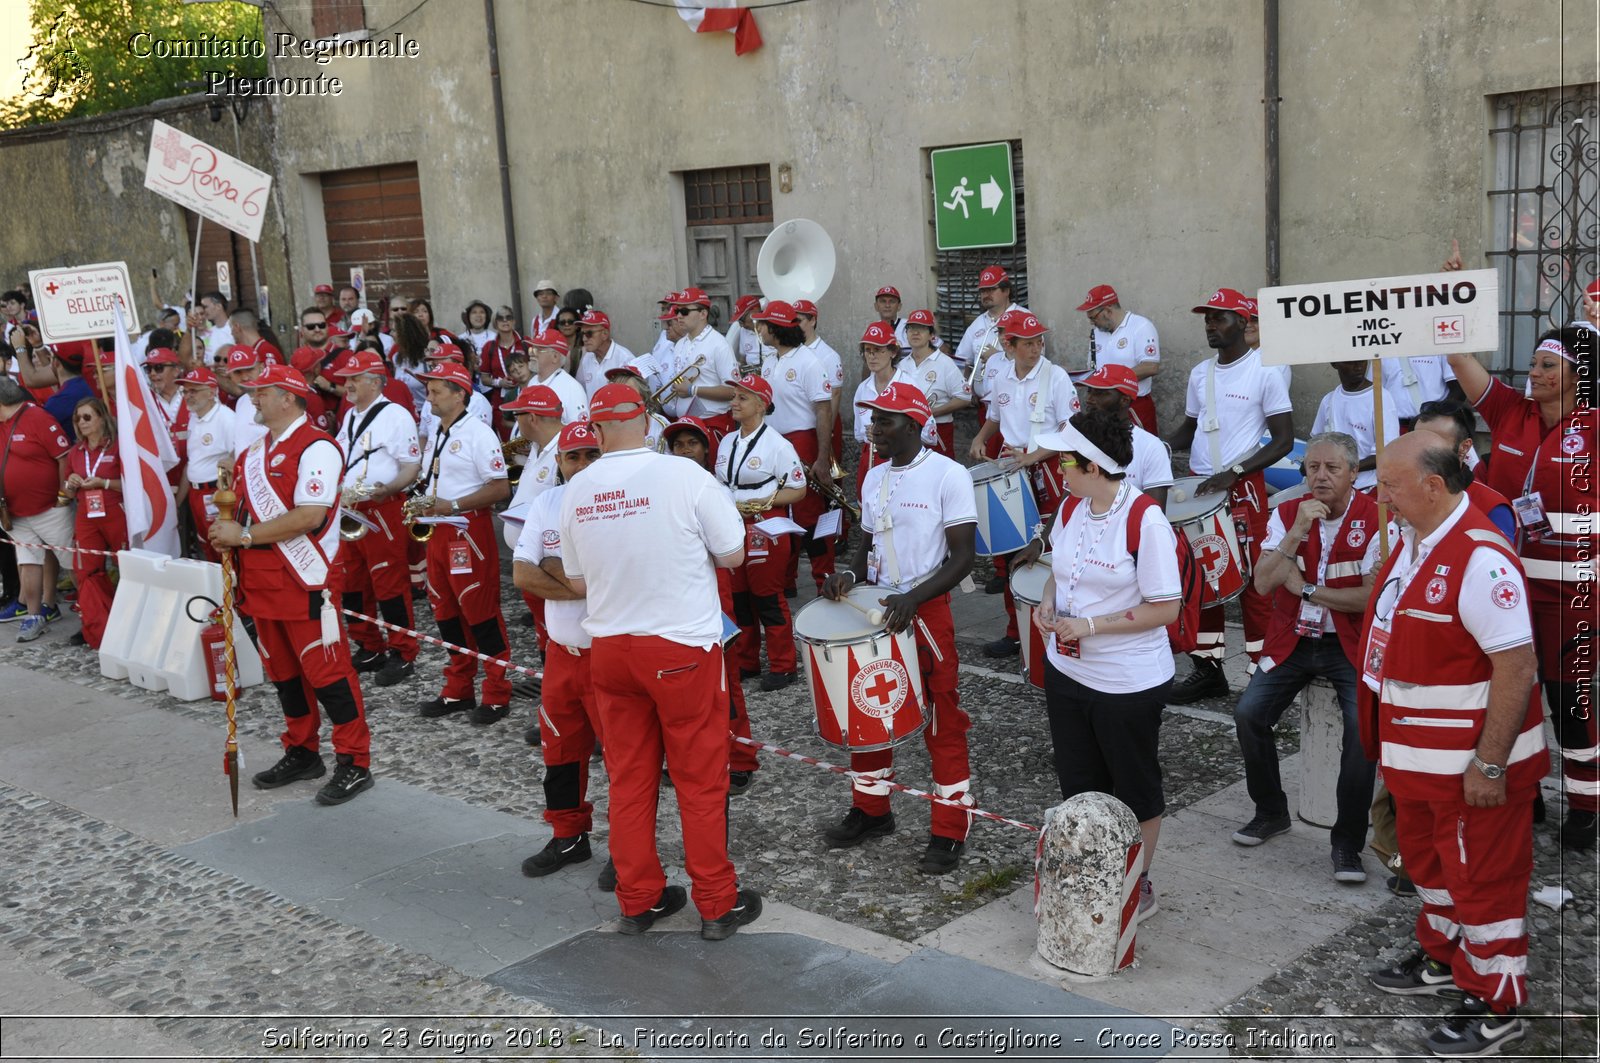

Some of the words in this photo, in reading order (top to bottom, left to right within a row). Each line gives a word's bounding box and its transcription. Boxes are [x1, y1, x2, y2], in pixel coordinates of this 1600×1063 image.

[159, 143, 238, 203] Roma
[243, 187, 266, 217] 6
[1277, 281, 1477, 319] TOLENTINO
[1357, 317, 1396, 331] -MC-
[1352, 332, 1403, 347] ITALY
[594, 489, 626, 504] FANFARA
[576, 506, 594, 517] CROCE
[596, 502, 617, 514] ROSSA
[618, 497, 650, 510] ITALIANA
[900, 502, 929, 510] FANFARA
[863, 660, 893, 675] GINEVRA
[892, 662, 900, 671] 22
[857, 672, 866, 681] DI
[897, 668, 907, 696] AGOSTO
[852, 679, 881, 717] CONVENZIONE
[891, 697, 904, 712] 1864
